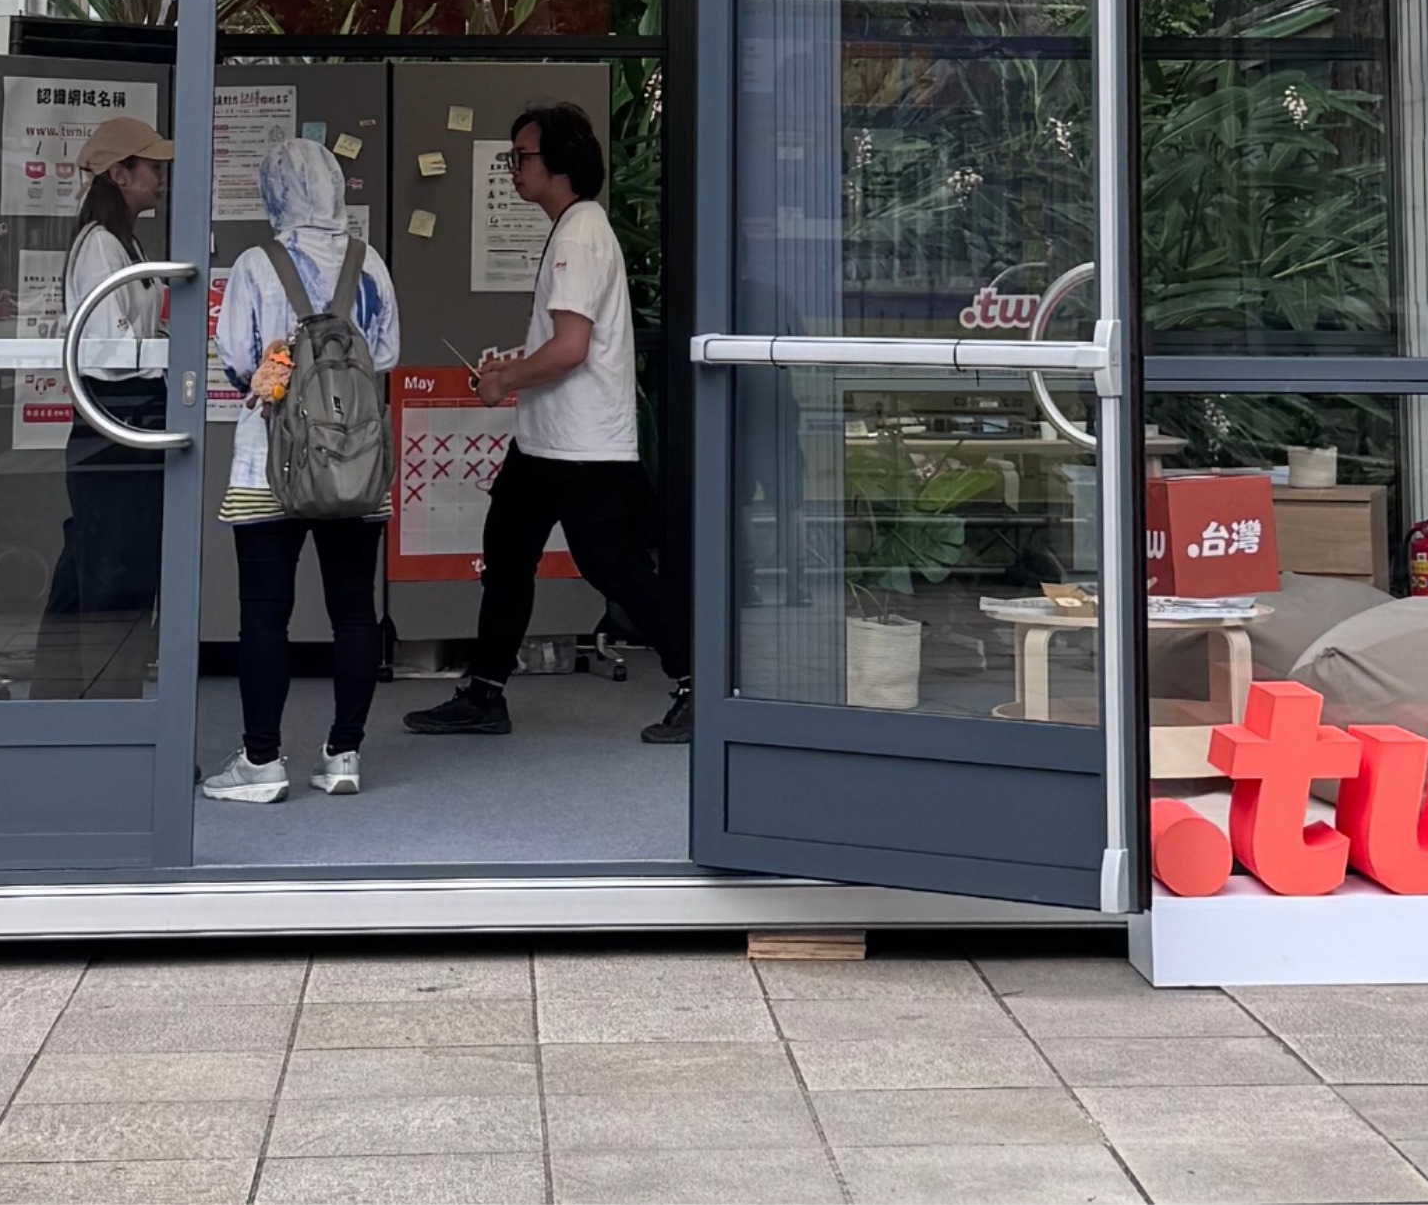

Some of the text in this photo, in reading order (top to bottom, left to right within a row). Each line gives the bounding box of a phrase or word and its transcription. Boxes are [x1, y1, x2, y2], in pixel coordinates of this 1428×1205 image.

[36, 86, 127, 108] 認識網域名稱
[403, 375, 436, 393] May
[1187, 518, 1262, 559] .台灣
